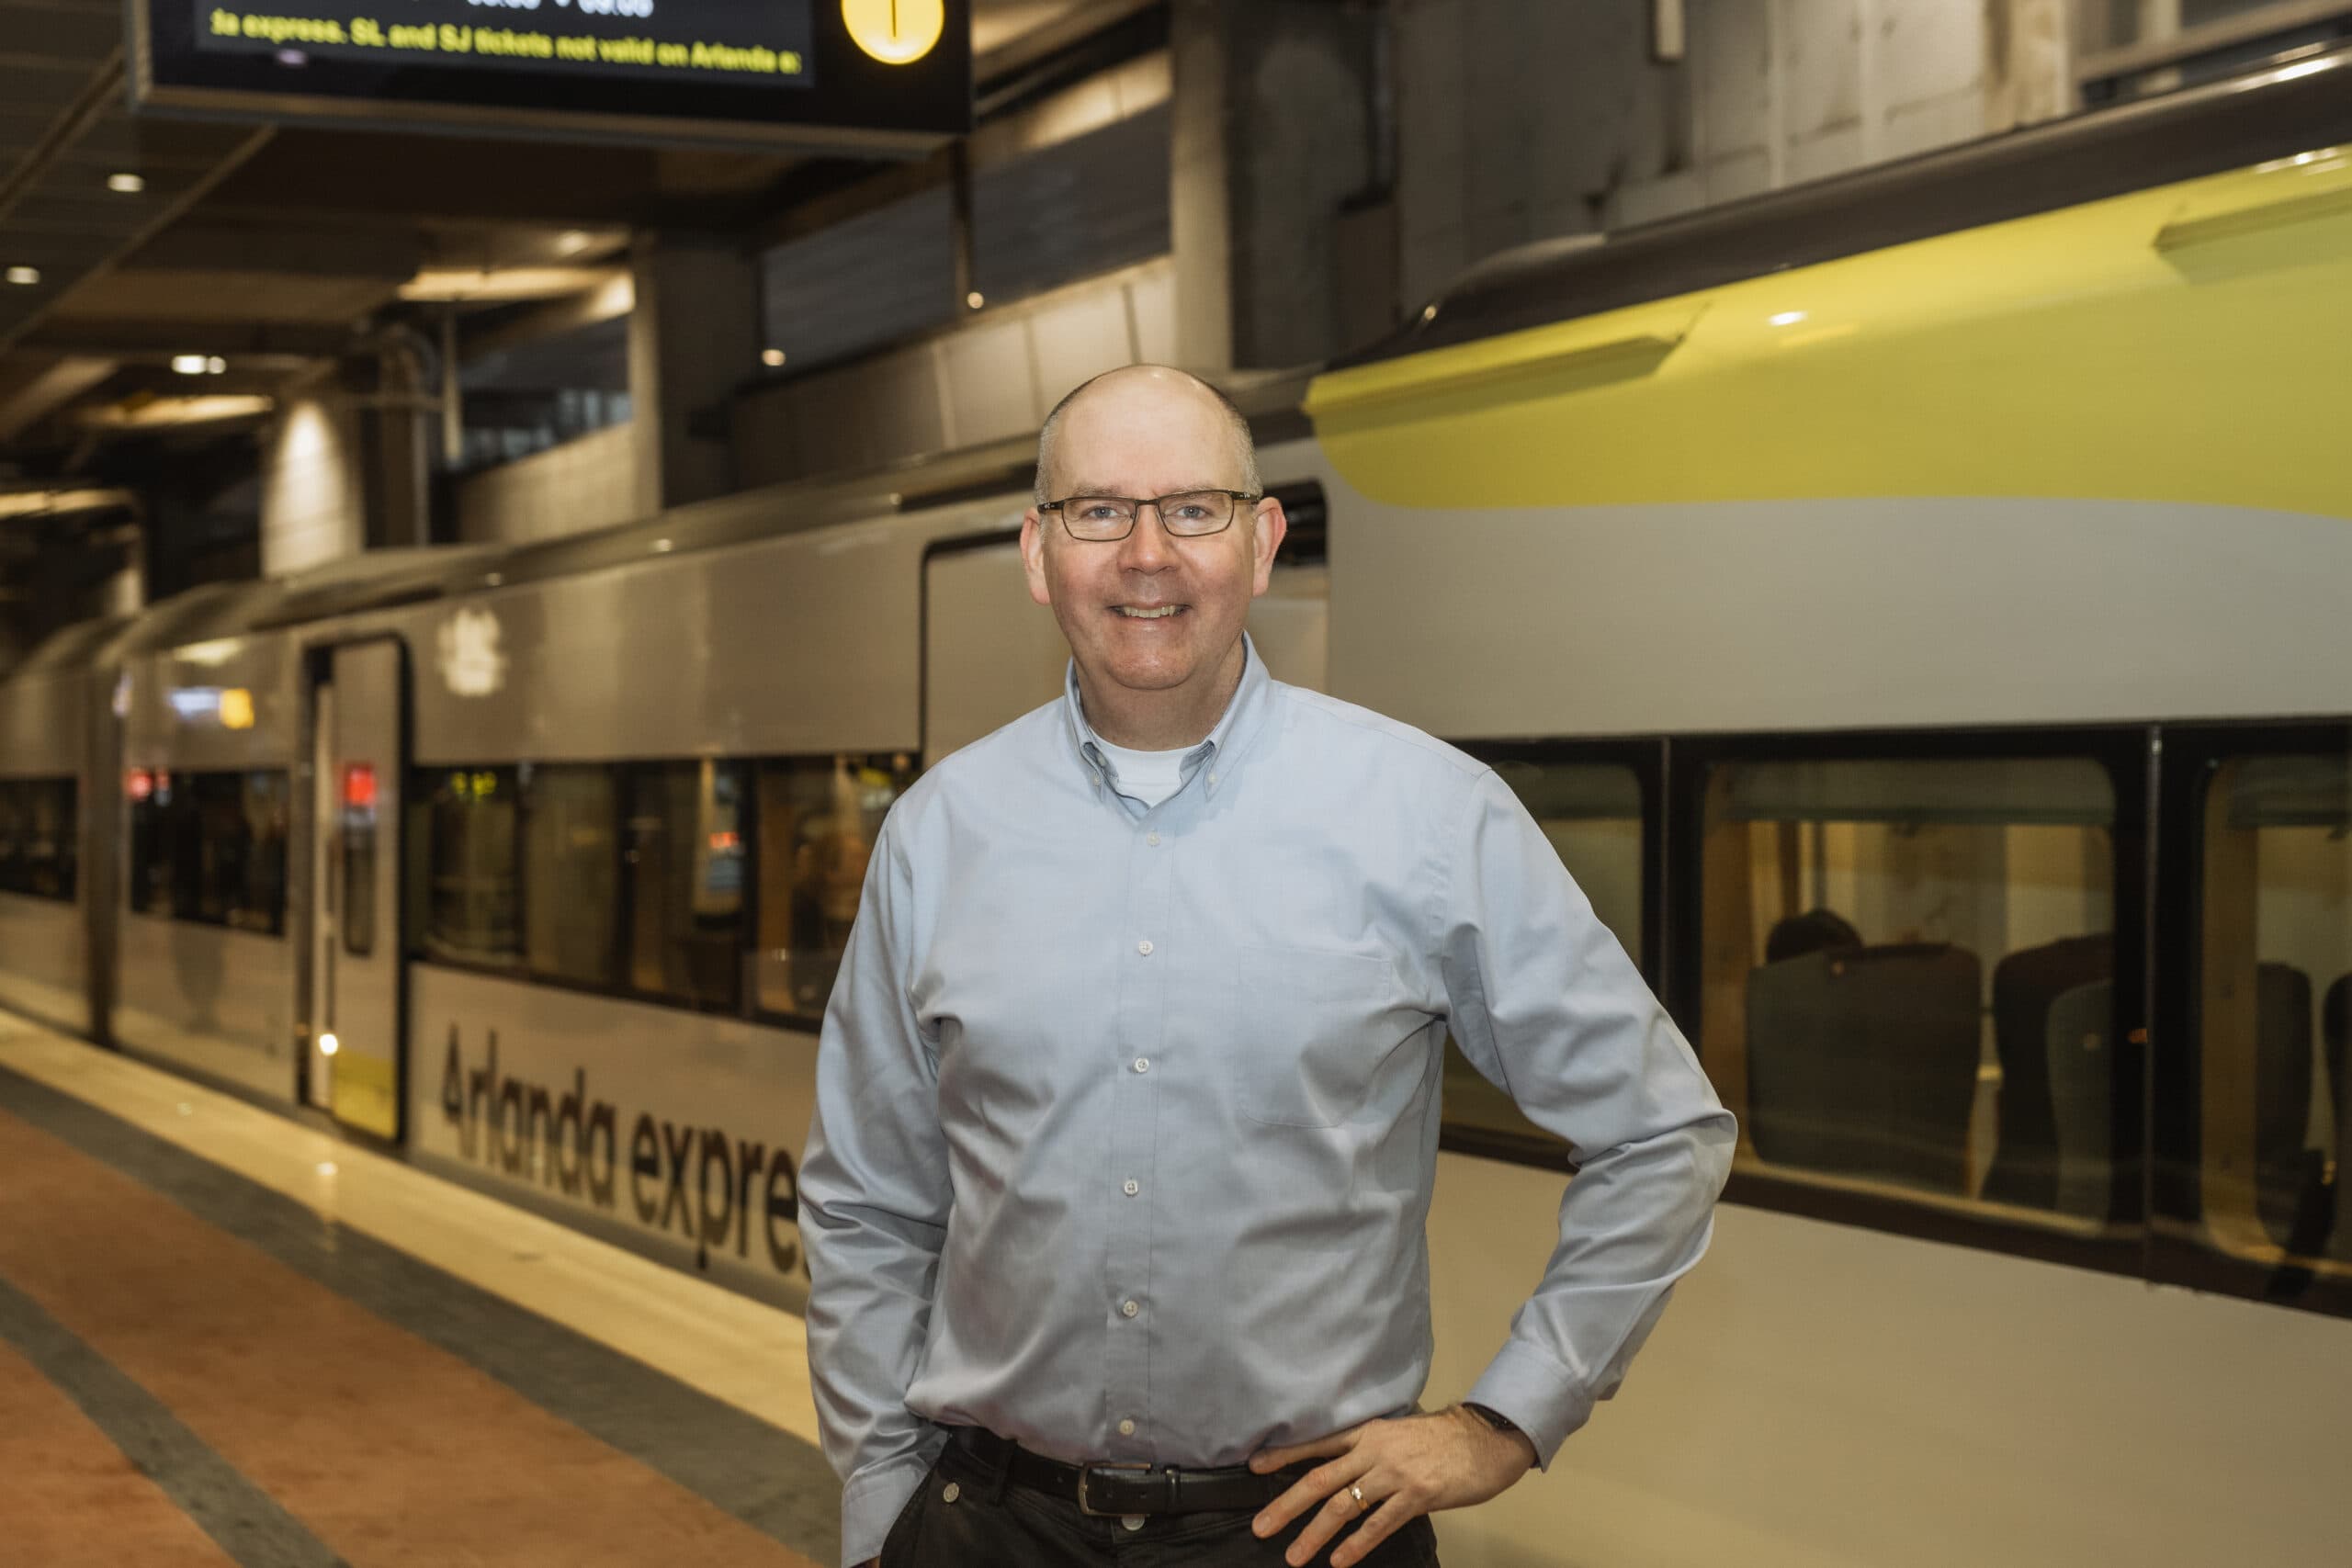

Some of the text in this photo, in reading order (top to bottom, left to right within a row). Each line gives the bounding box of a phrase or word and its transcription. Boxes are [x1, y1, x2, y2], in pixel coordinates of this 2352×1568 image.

[350, 17, 386, 46] SL
[388, 23, 437, 50] and
[438, 23, 472, 52] SJ
[474, 27, 553, 58] tickets
[555, 35, 597, 62] not
[598, 37, 655, 65] valid
[656, 42, 688, 67] on
[691, 41, 777, 73] Arlanda
[442, 1021, 812, 1278] Arlanda expre
